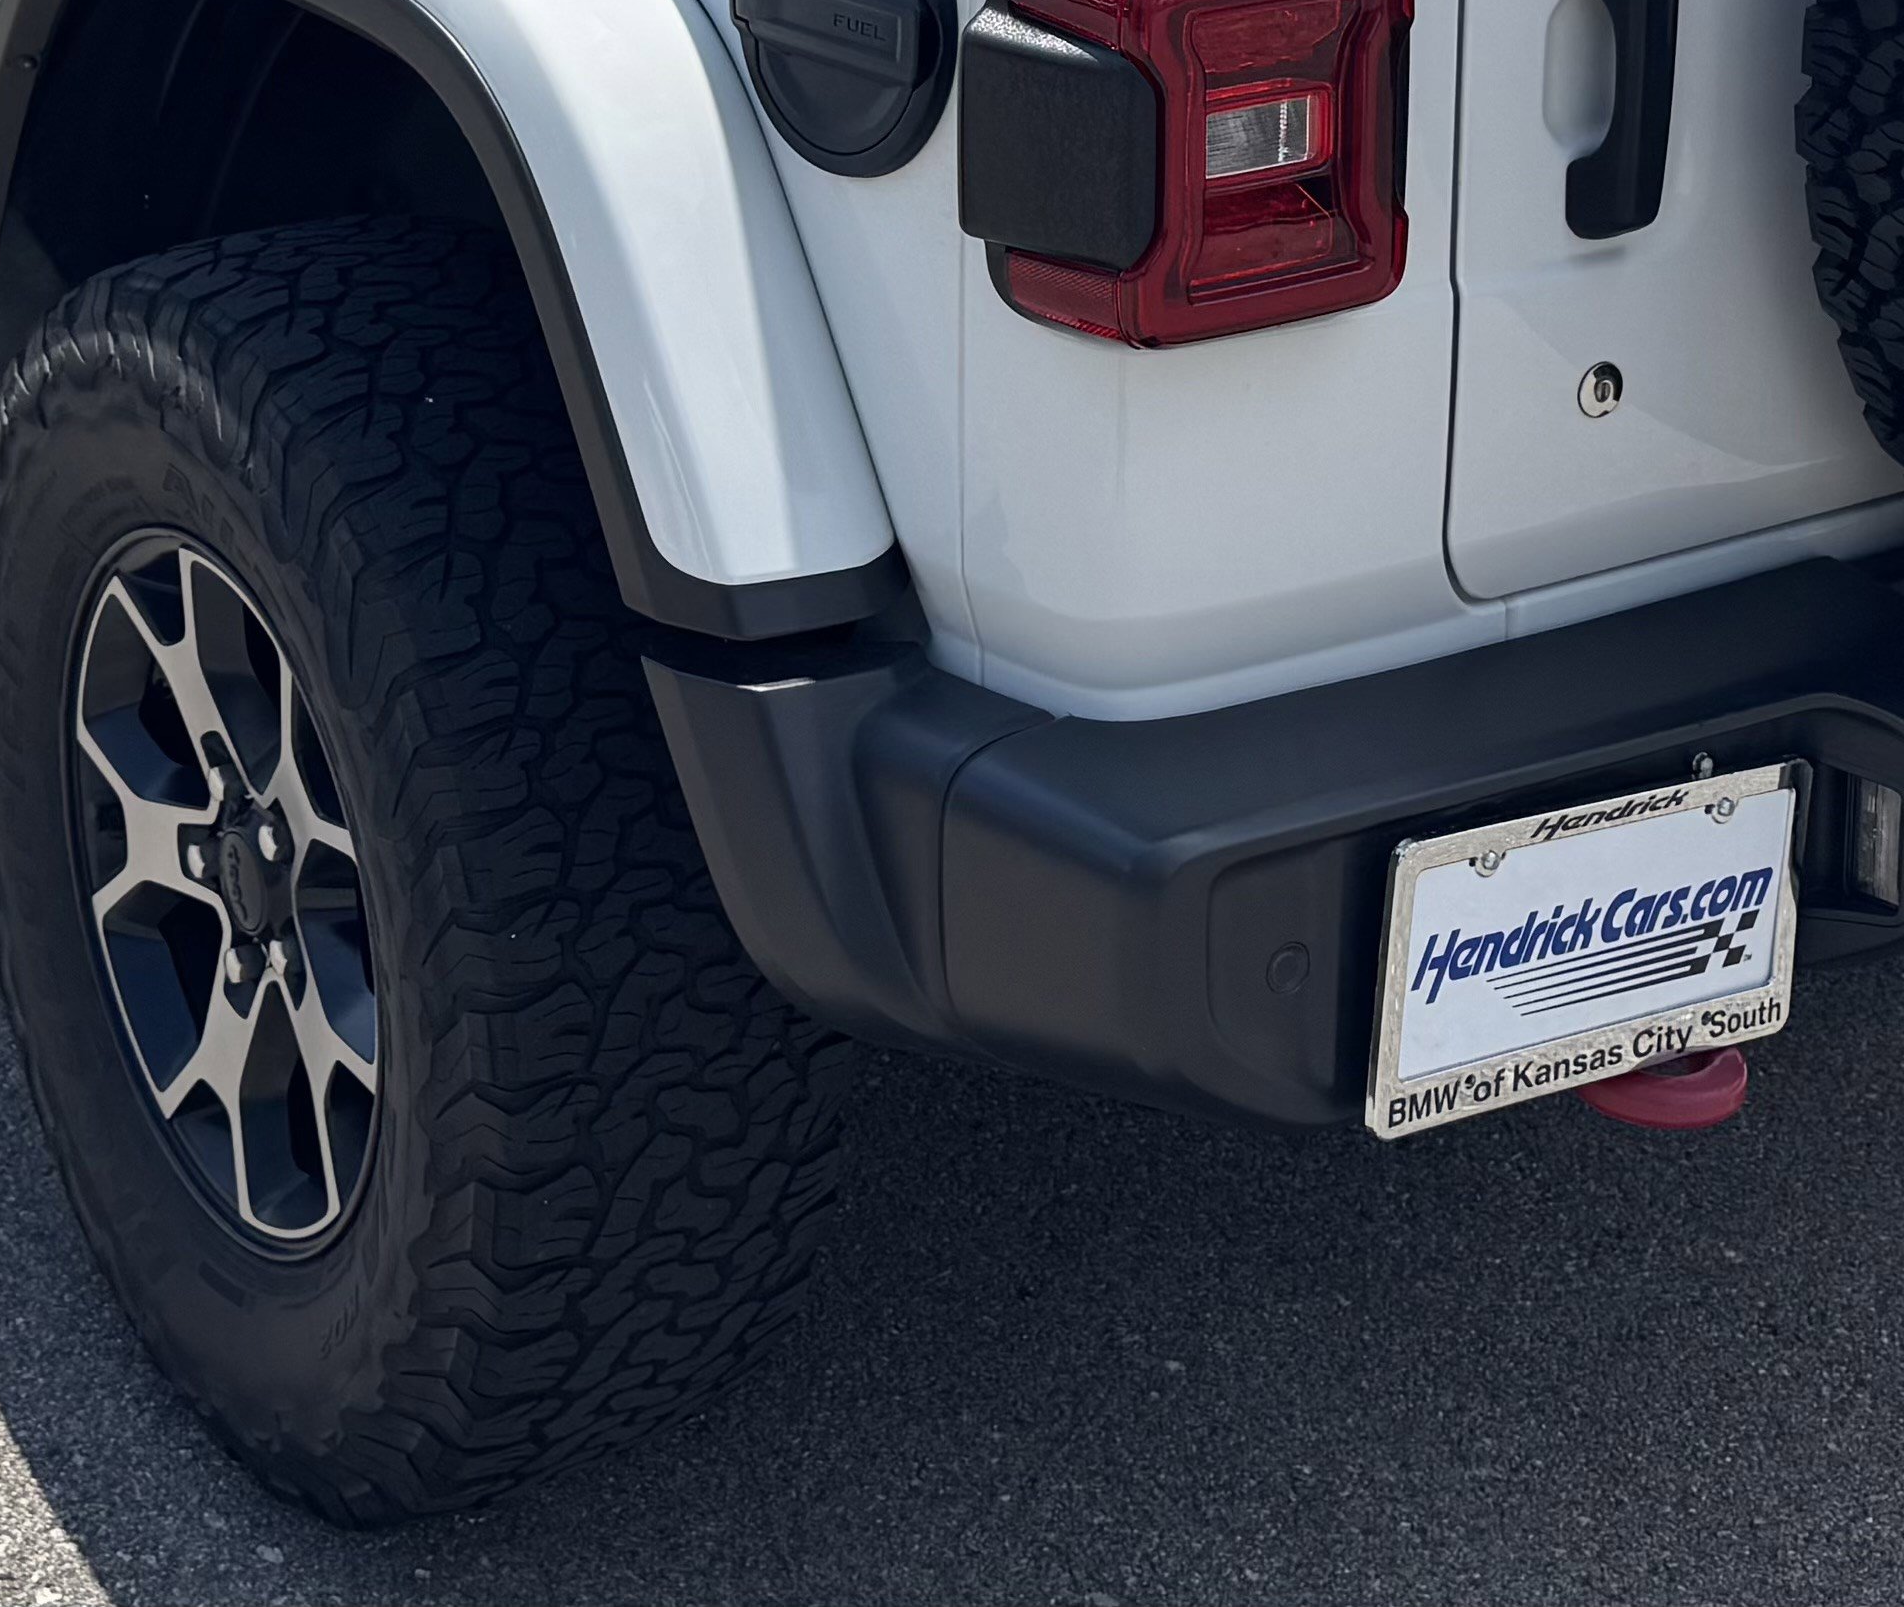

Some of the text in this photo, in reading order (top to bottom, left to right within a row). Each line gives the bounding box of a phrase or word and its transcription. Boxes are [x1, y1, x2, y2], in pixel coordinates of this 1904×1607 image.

[832, 12, 887, 43] FUEL
[1530, 789, 1689, 841] Hendrick
[1387, 997, 1782, 1129] BMW of Kansas City South
